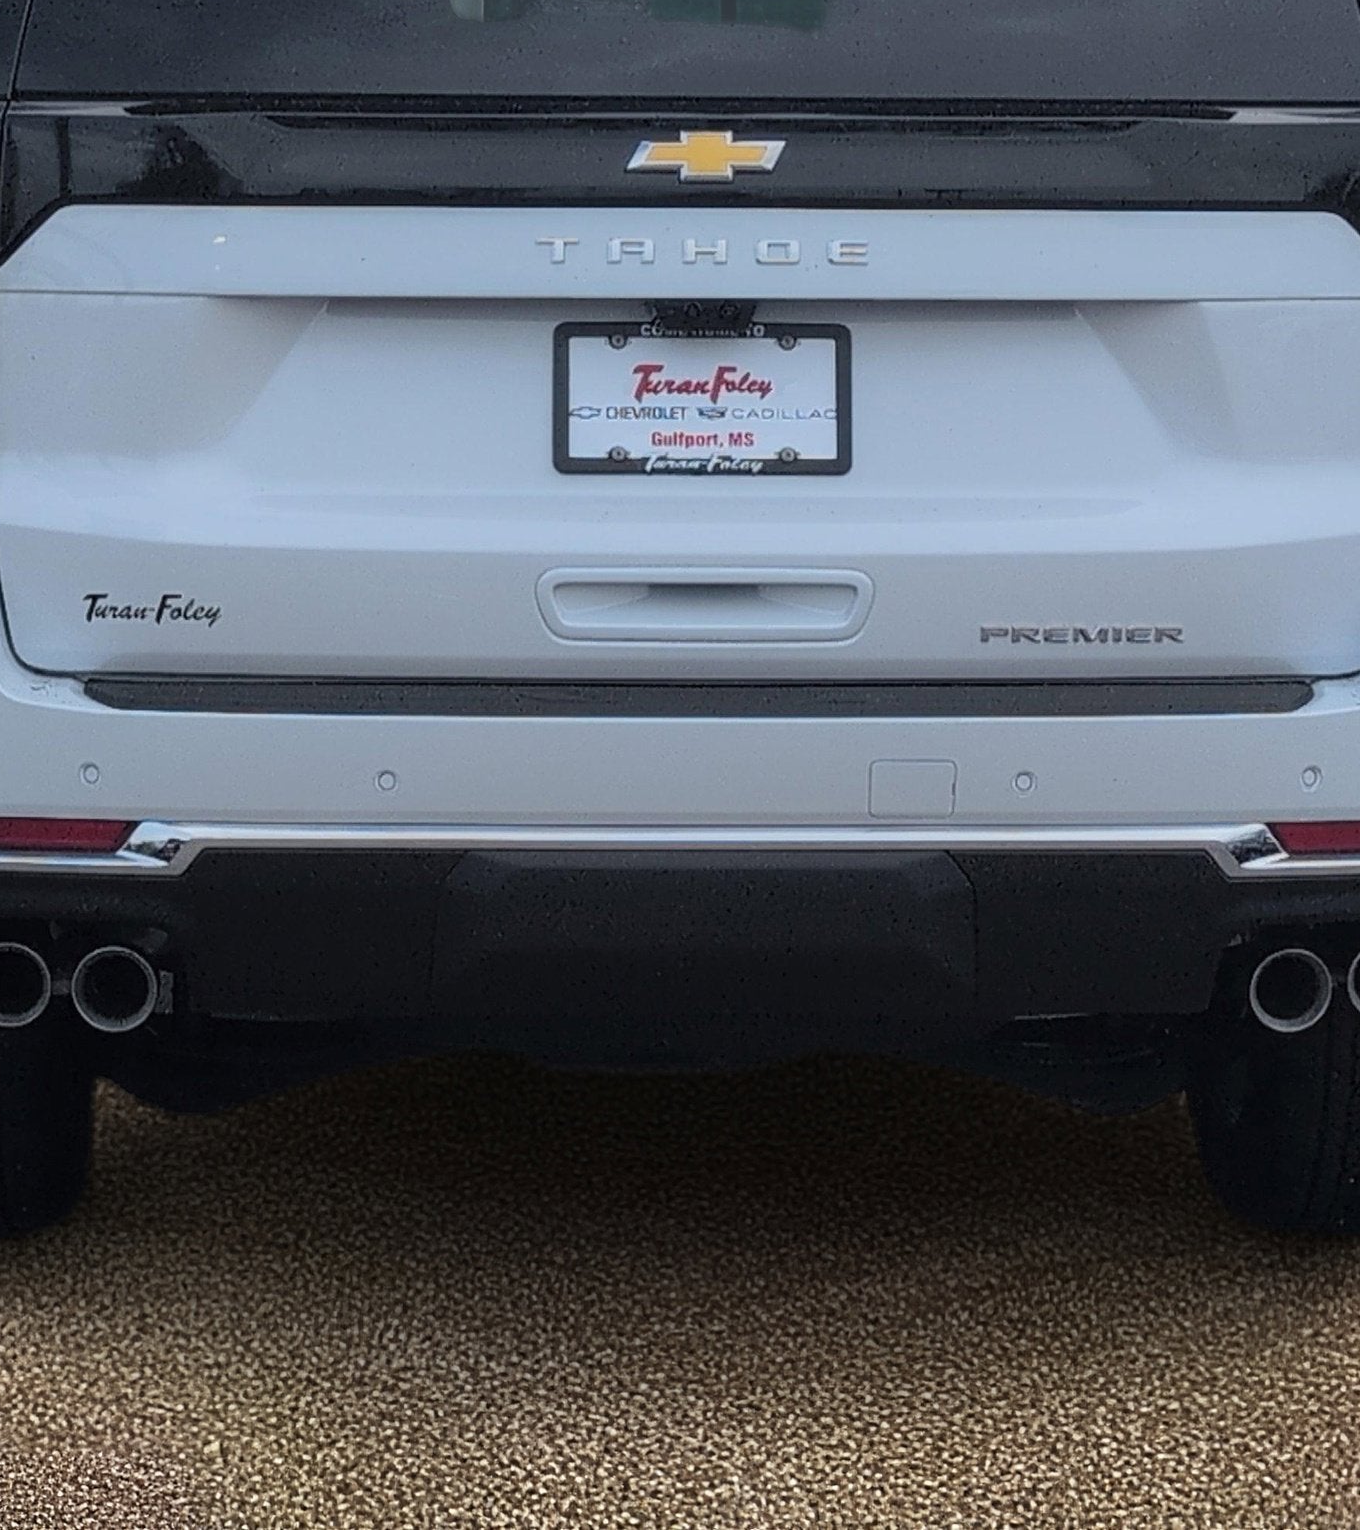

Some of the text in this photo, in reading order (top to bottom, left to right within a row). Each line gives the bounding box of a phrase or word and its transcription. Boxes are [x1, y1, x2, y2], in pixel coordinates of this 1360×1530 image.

[535, 237, 869, 266] TAHOE
[605, 406, 838, 420] CHEVROLET CADILLAC
[651, 431, 754, 448] Gulfport, MS
[980, 626, 1184, 644] PREMIER
